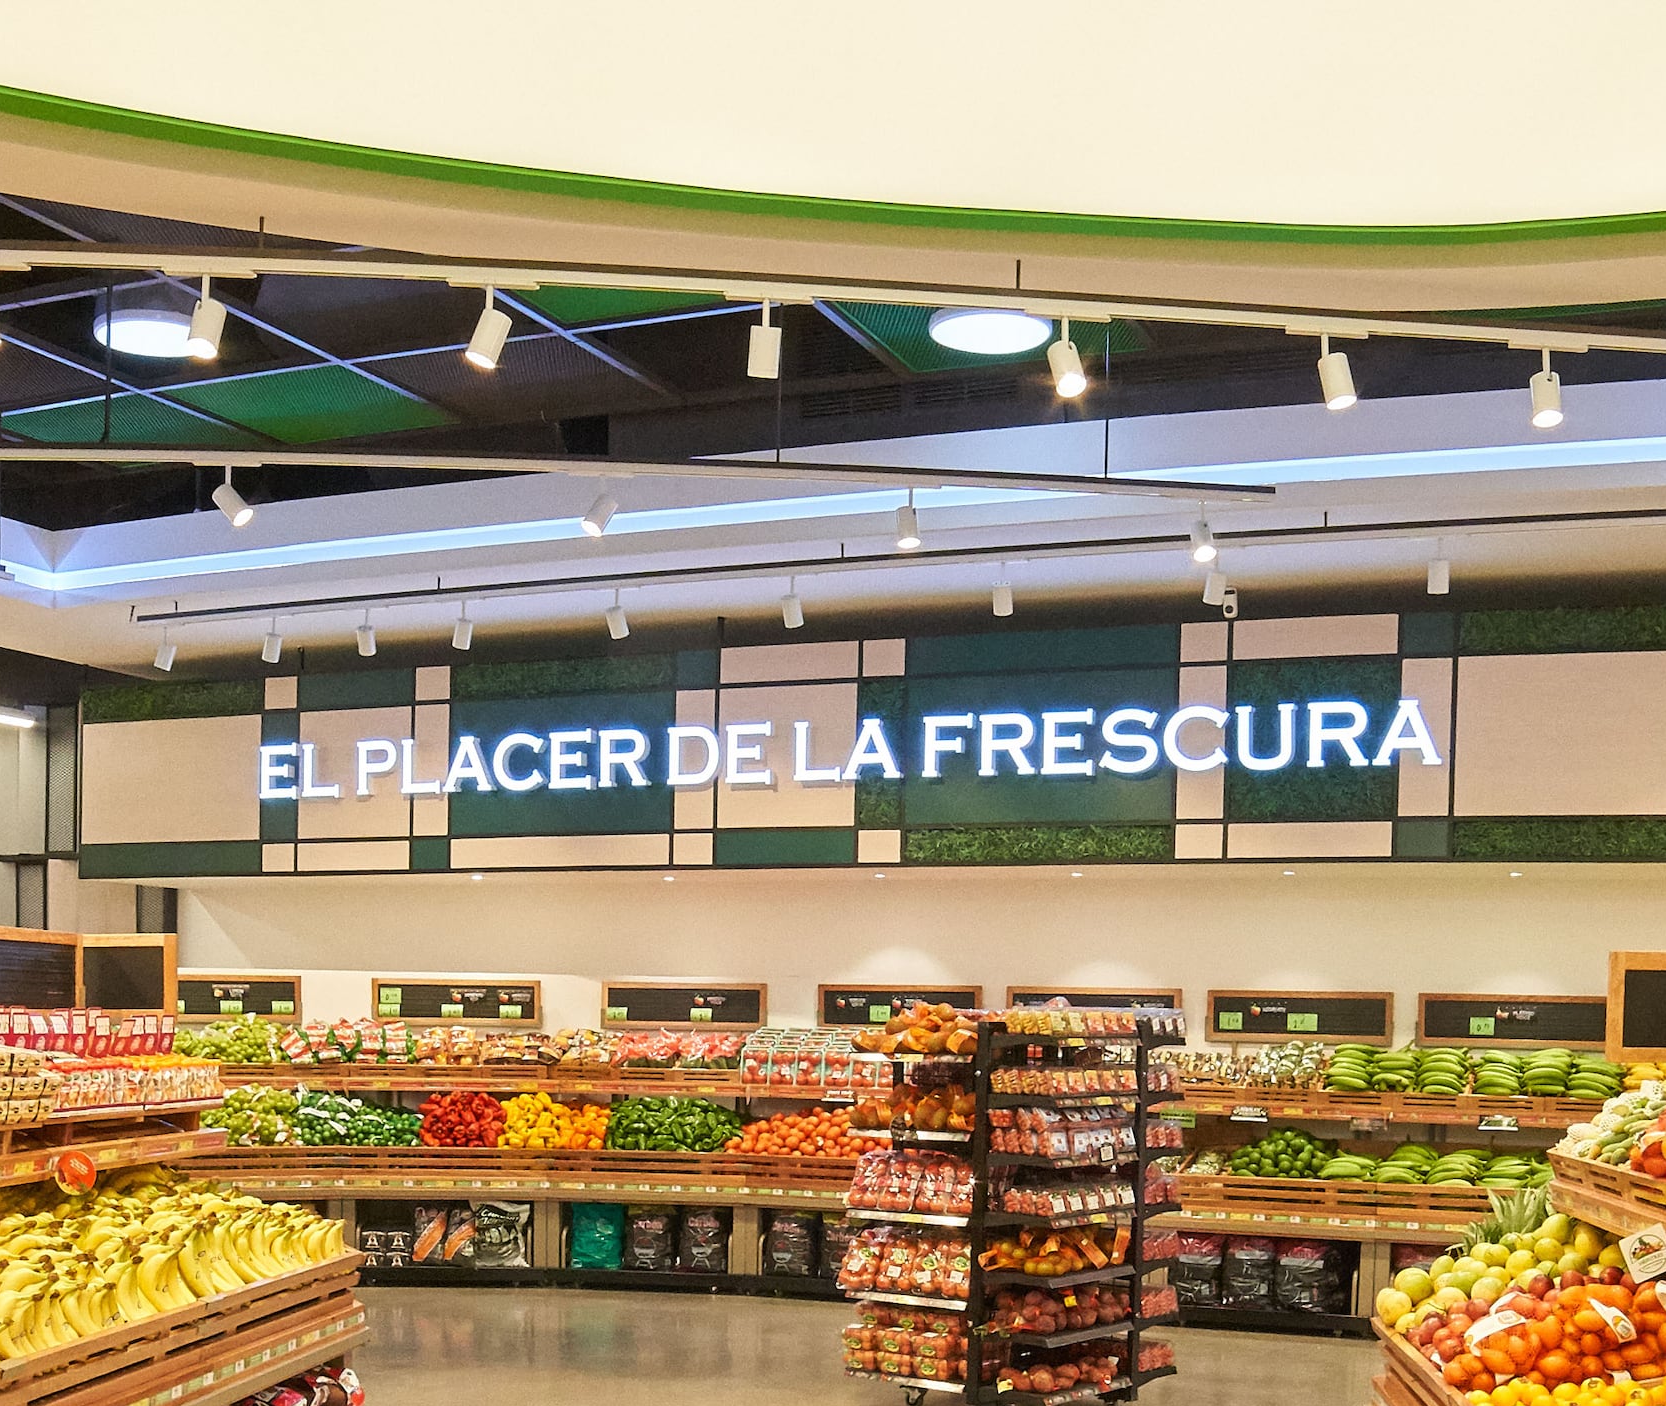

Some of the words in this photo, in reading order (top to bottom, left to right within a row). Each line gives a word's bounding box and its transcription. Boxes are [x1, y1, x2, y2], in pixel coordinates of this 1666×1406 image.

[257, 739, 341, 802] EL
[355, 726, 651, 797] PLACER
[665, 719, 775, 787] DE
[792, 716, 902, 784] LA
[920, 698, 1445, 780] FRESCURA
